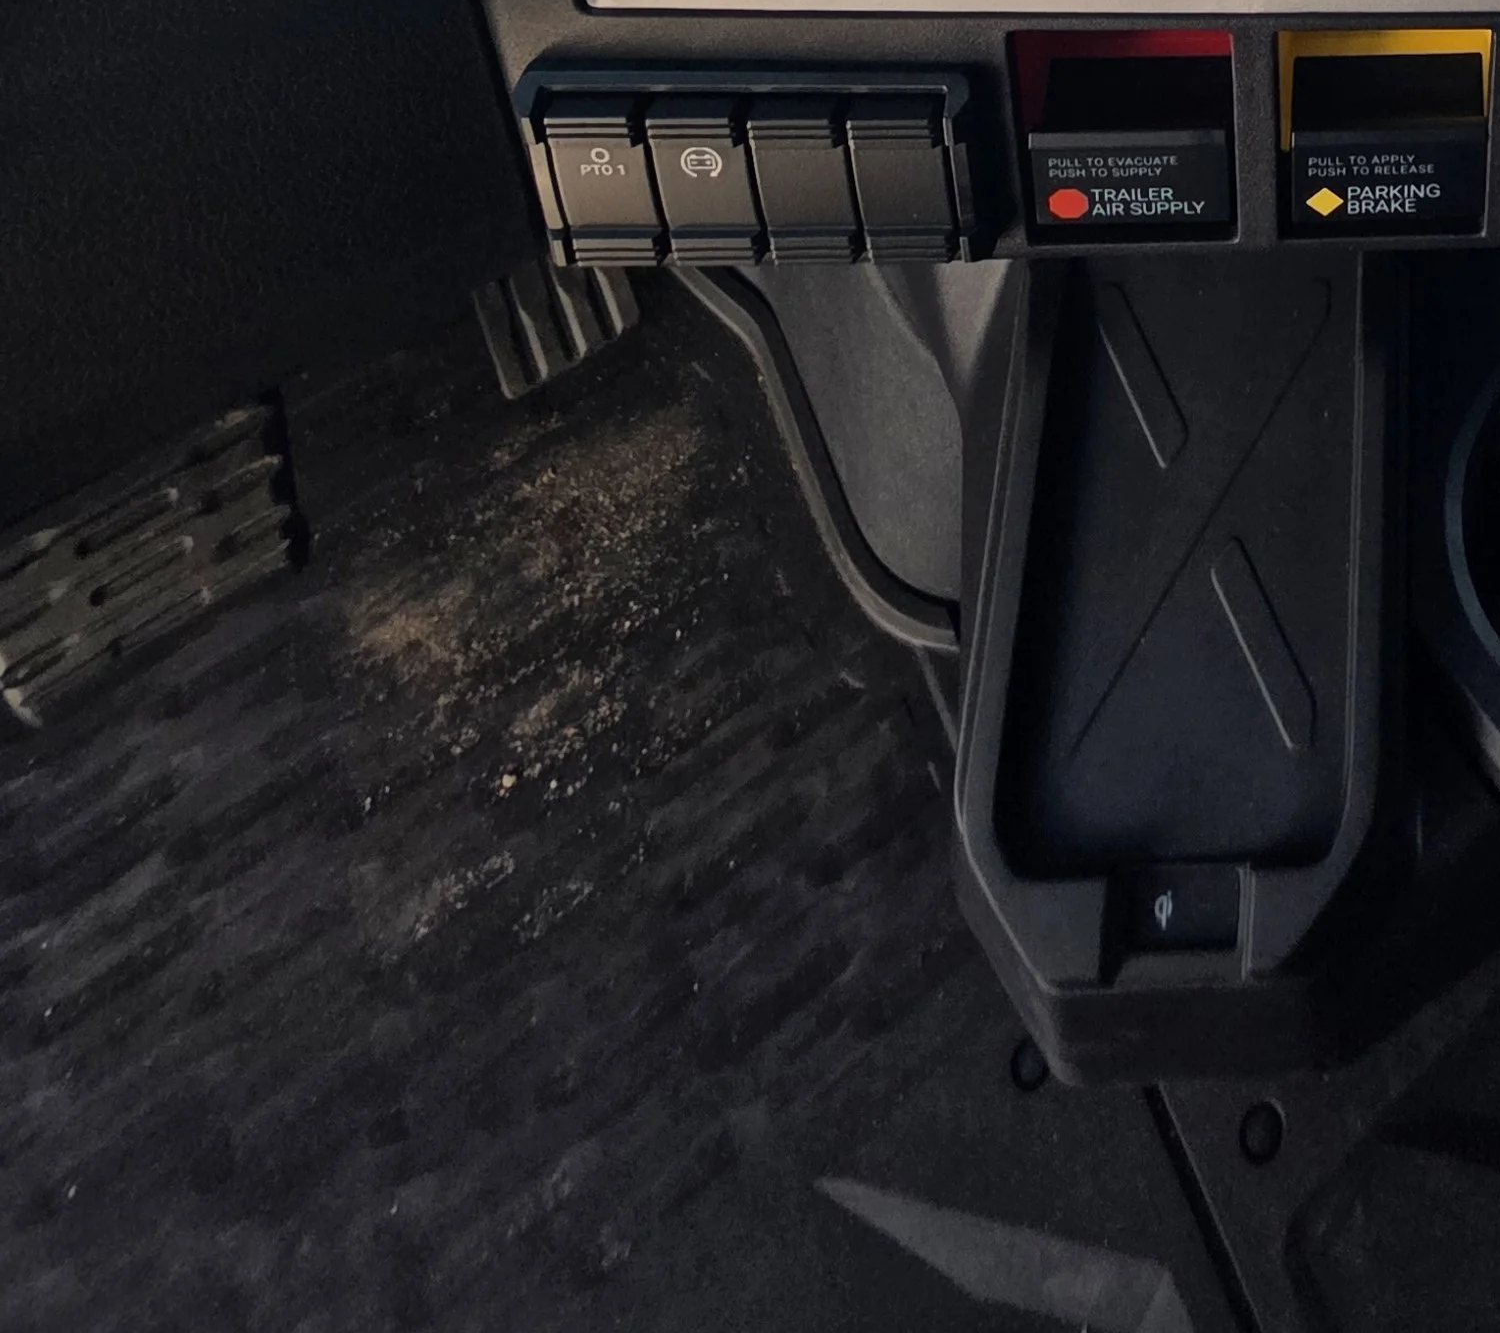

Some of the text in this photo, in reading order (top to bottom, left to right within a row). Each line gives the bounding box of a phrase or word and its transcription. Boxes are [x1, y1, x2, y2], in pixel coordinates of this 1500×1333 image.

[1048, 155, 1179, 168] PULL TO EVACUATE
[1308, 154, 1416, 167] PULL TO APPLY
[580, 163, 626, 176] PTO 1
[1048, 166, 1163, 178] PUSH TO SUPPLY
[1308, 163, 1435, 178] PUSH TO RELEASE
[1091, 187, 1174, 202] TRAILER
[1347, 183, 1441, 200] PARKING
[1091, 200, 1206, 217] AIR SUPPLY
[1347, 198, 1417, 215] BRAKE
